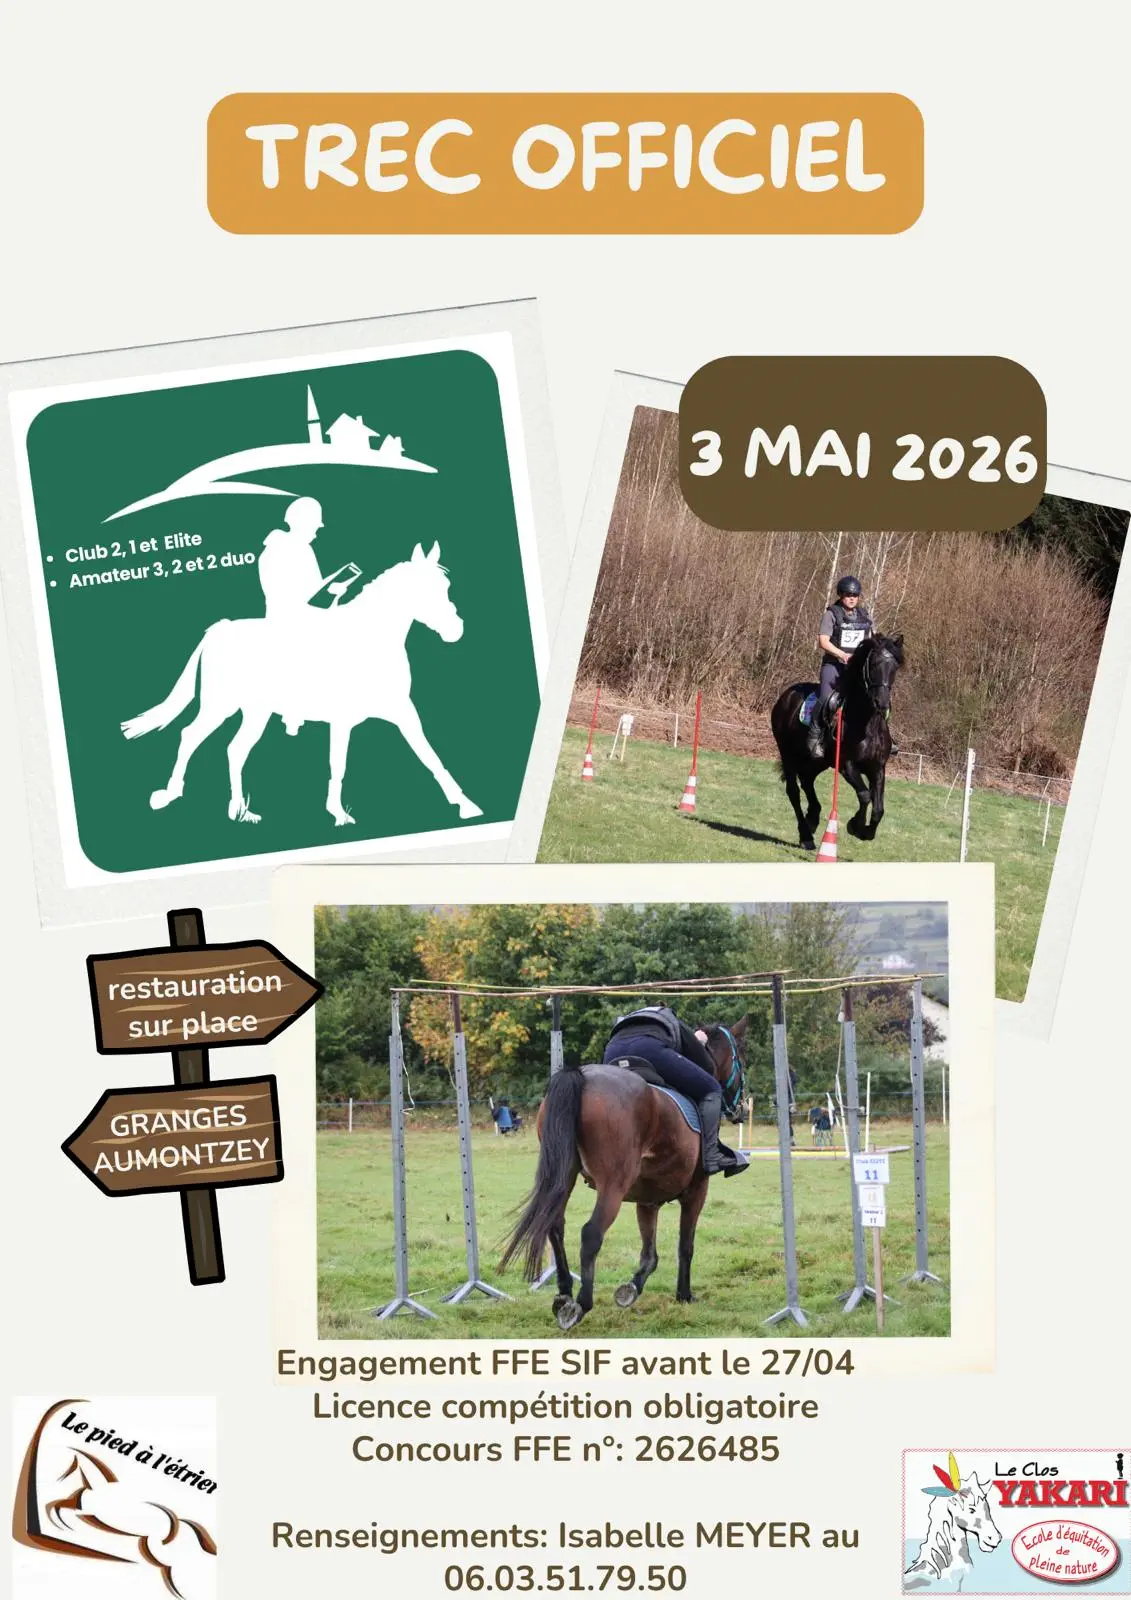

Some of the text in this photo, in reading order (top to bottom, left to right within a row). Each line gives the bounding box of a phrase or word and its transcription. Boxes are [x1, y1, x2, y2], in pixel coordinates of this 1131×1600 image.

[246, 119, 885, 194] TREC OFFICIEL
[690, 425, 1037, 483] 3 MAI 2026
[65, 532, 202, 563] Club 2, 1 et Elite
[69, 551, 256, 588] Amateur 3, 2 et 2 duo
[844, 631, 860, 643] 57
[109, 970, 282, 1000] restauration
[129, 1011, 258, 1040] sur place
[110, 1104, 247, 1137] GRANGES
[93, 1137, 270, 1174] AUMONTZEY
[278, 1348, 854, 1381] Engagement FFE SIF avant le 27/04
[314, 1391, 818, 1424] Licence compétition obligatoire
[61, 1411, 217, 1494] Le pied à l'étrier
[353, 1436, 502, 1461] Concours
[515, 1436, 571, 1461] FFE
[635, 1436, 779, 1461] 2626485
[995, 1462, 1059, 1477] Le Clos
[992, 1480, 1129, 1507] YAKARI
[273, 1522, 858, 1554] Renseignements: Isabelle MEYER au
[1021, 1525, 1110, 1558] Ecole d'équitation
[1055, 1546, 1070, 1556] de
[445, 1565, 686, 1591] 06.03.51.79.50
[1029, 1555, 1098, 1575] pleine nature
